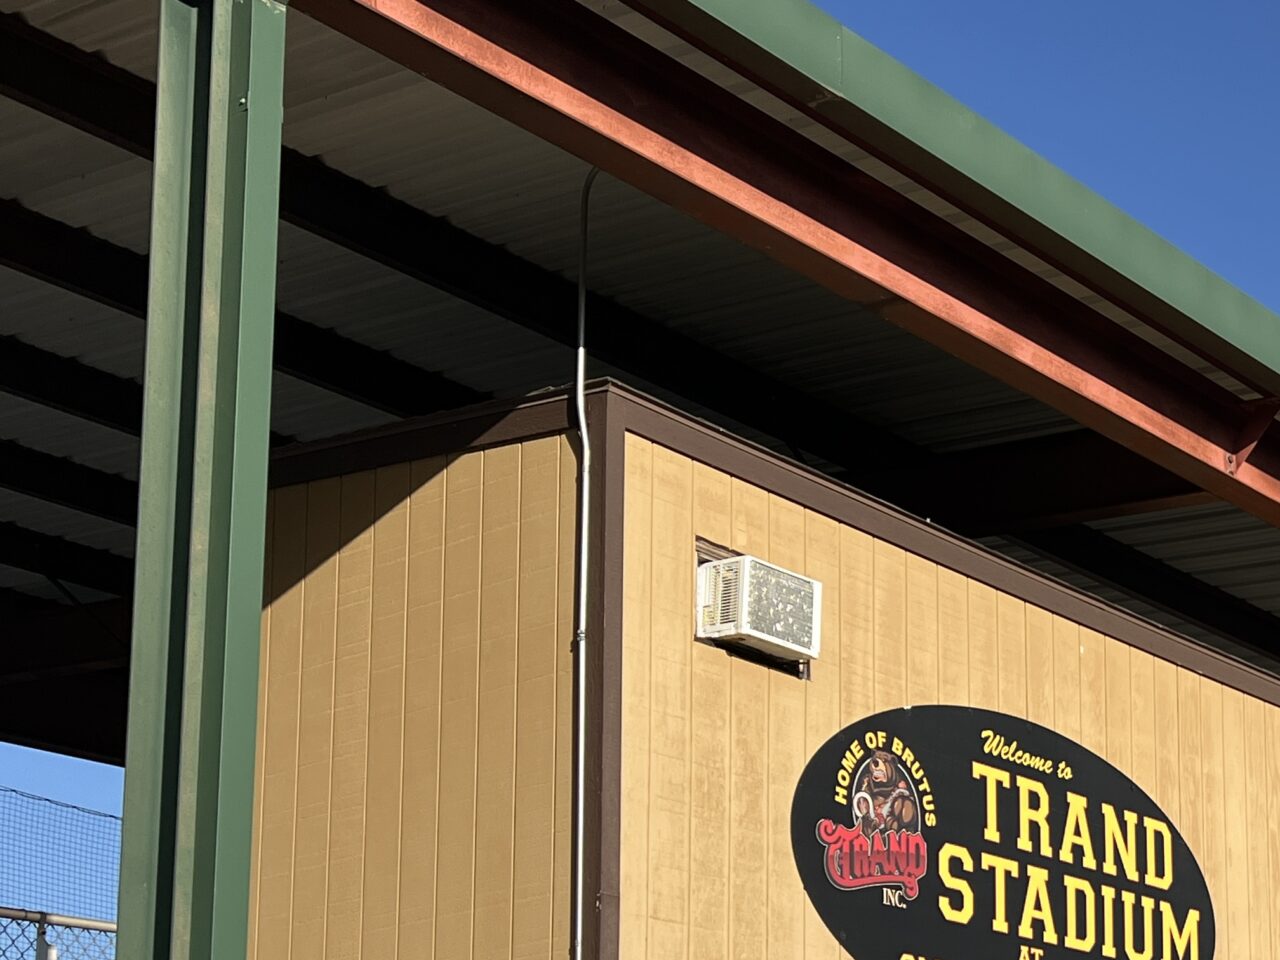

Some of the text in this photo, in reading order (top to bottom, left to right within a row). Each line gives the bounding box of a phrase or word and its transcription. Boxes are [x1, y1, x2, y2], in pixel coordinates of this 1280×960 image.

[835, 731, 937, 827] HOME OF BRUTUS
[980, 730, 1073, 781] Welcome to
[817, 818, 927, 900] TRAND
[972, 761, 1174, 890] TRAND
[882, 887, 907, 909] INC.
